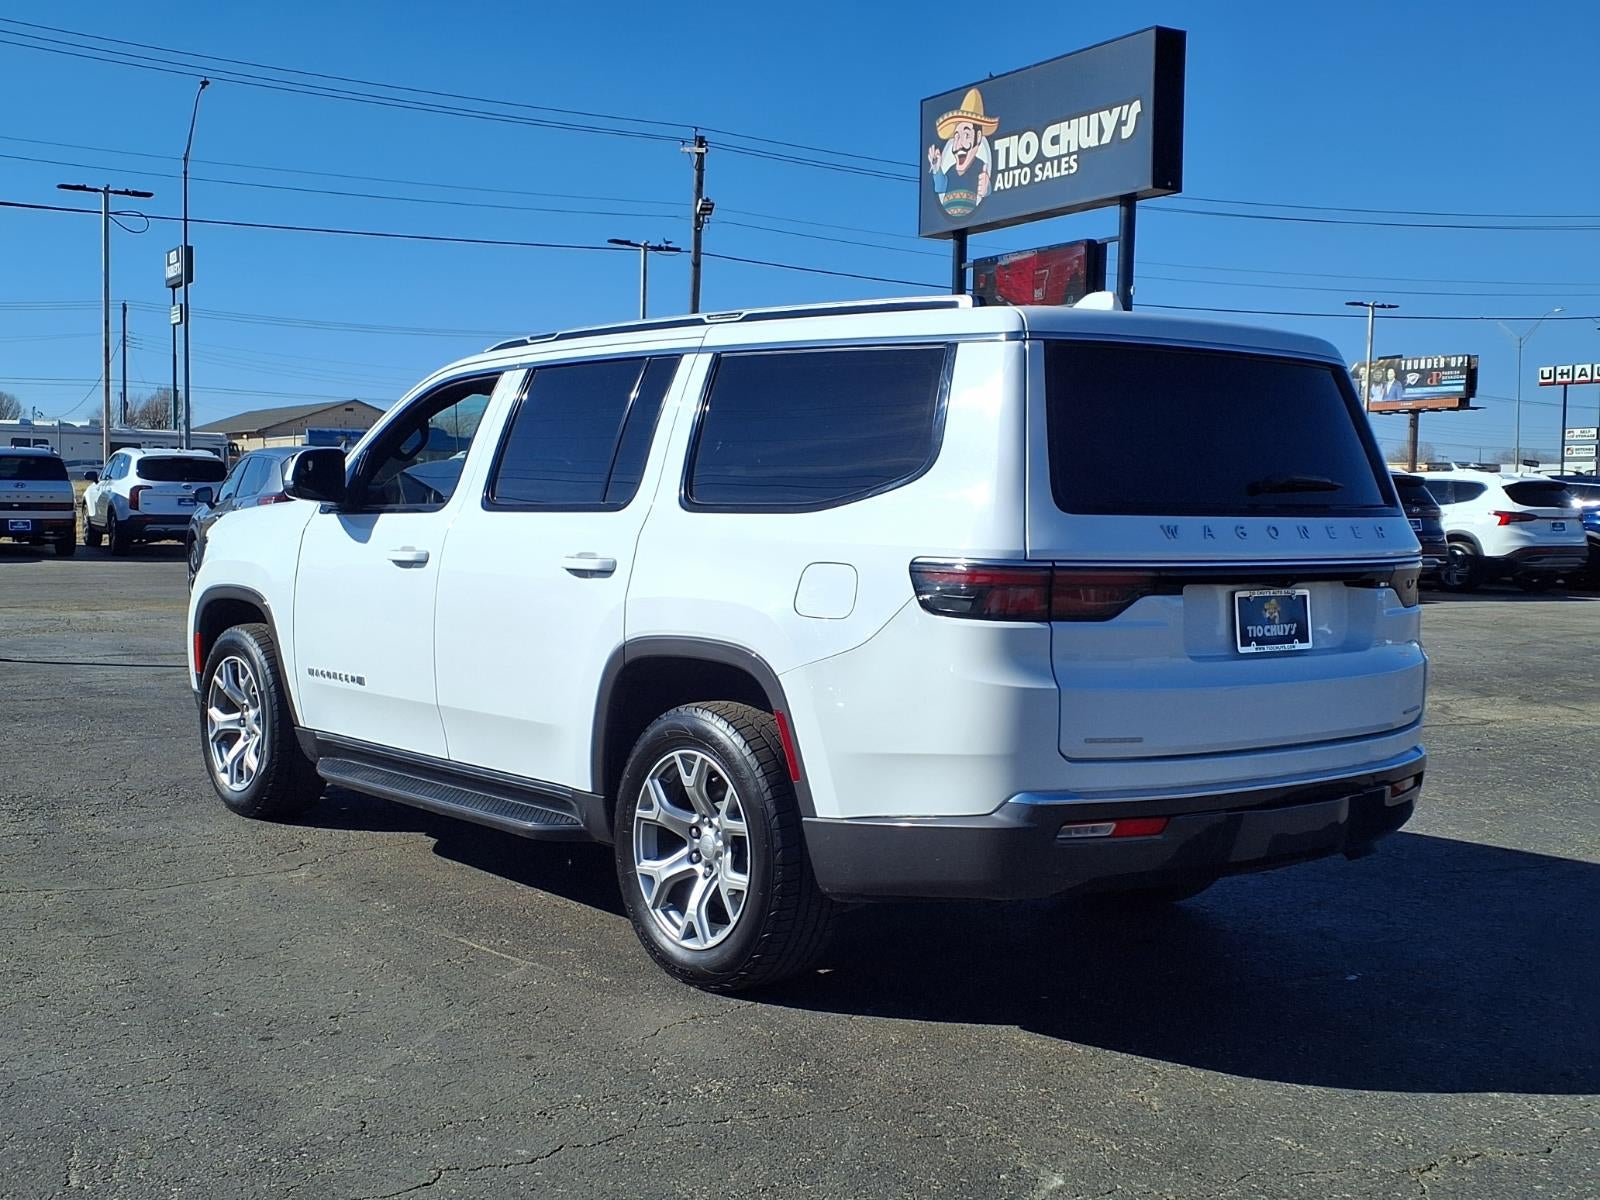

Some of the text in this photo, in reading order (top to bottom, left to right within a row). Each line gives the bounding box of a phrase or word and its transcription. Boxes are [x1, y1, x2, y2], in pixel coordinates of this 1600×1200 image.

[994, 99, 1142, 171] TIO CHUY'S
[994, 154, 1078, 192] AUTO SALES
[1401, 356, 1468, 371] THUNDER UP!
[1160, 524, 1385, 541] WAGONEER
[1247, 622, 1297, 638] TIO CHUY'S
[308, 668, 355, 683] WAGONEER
